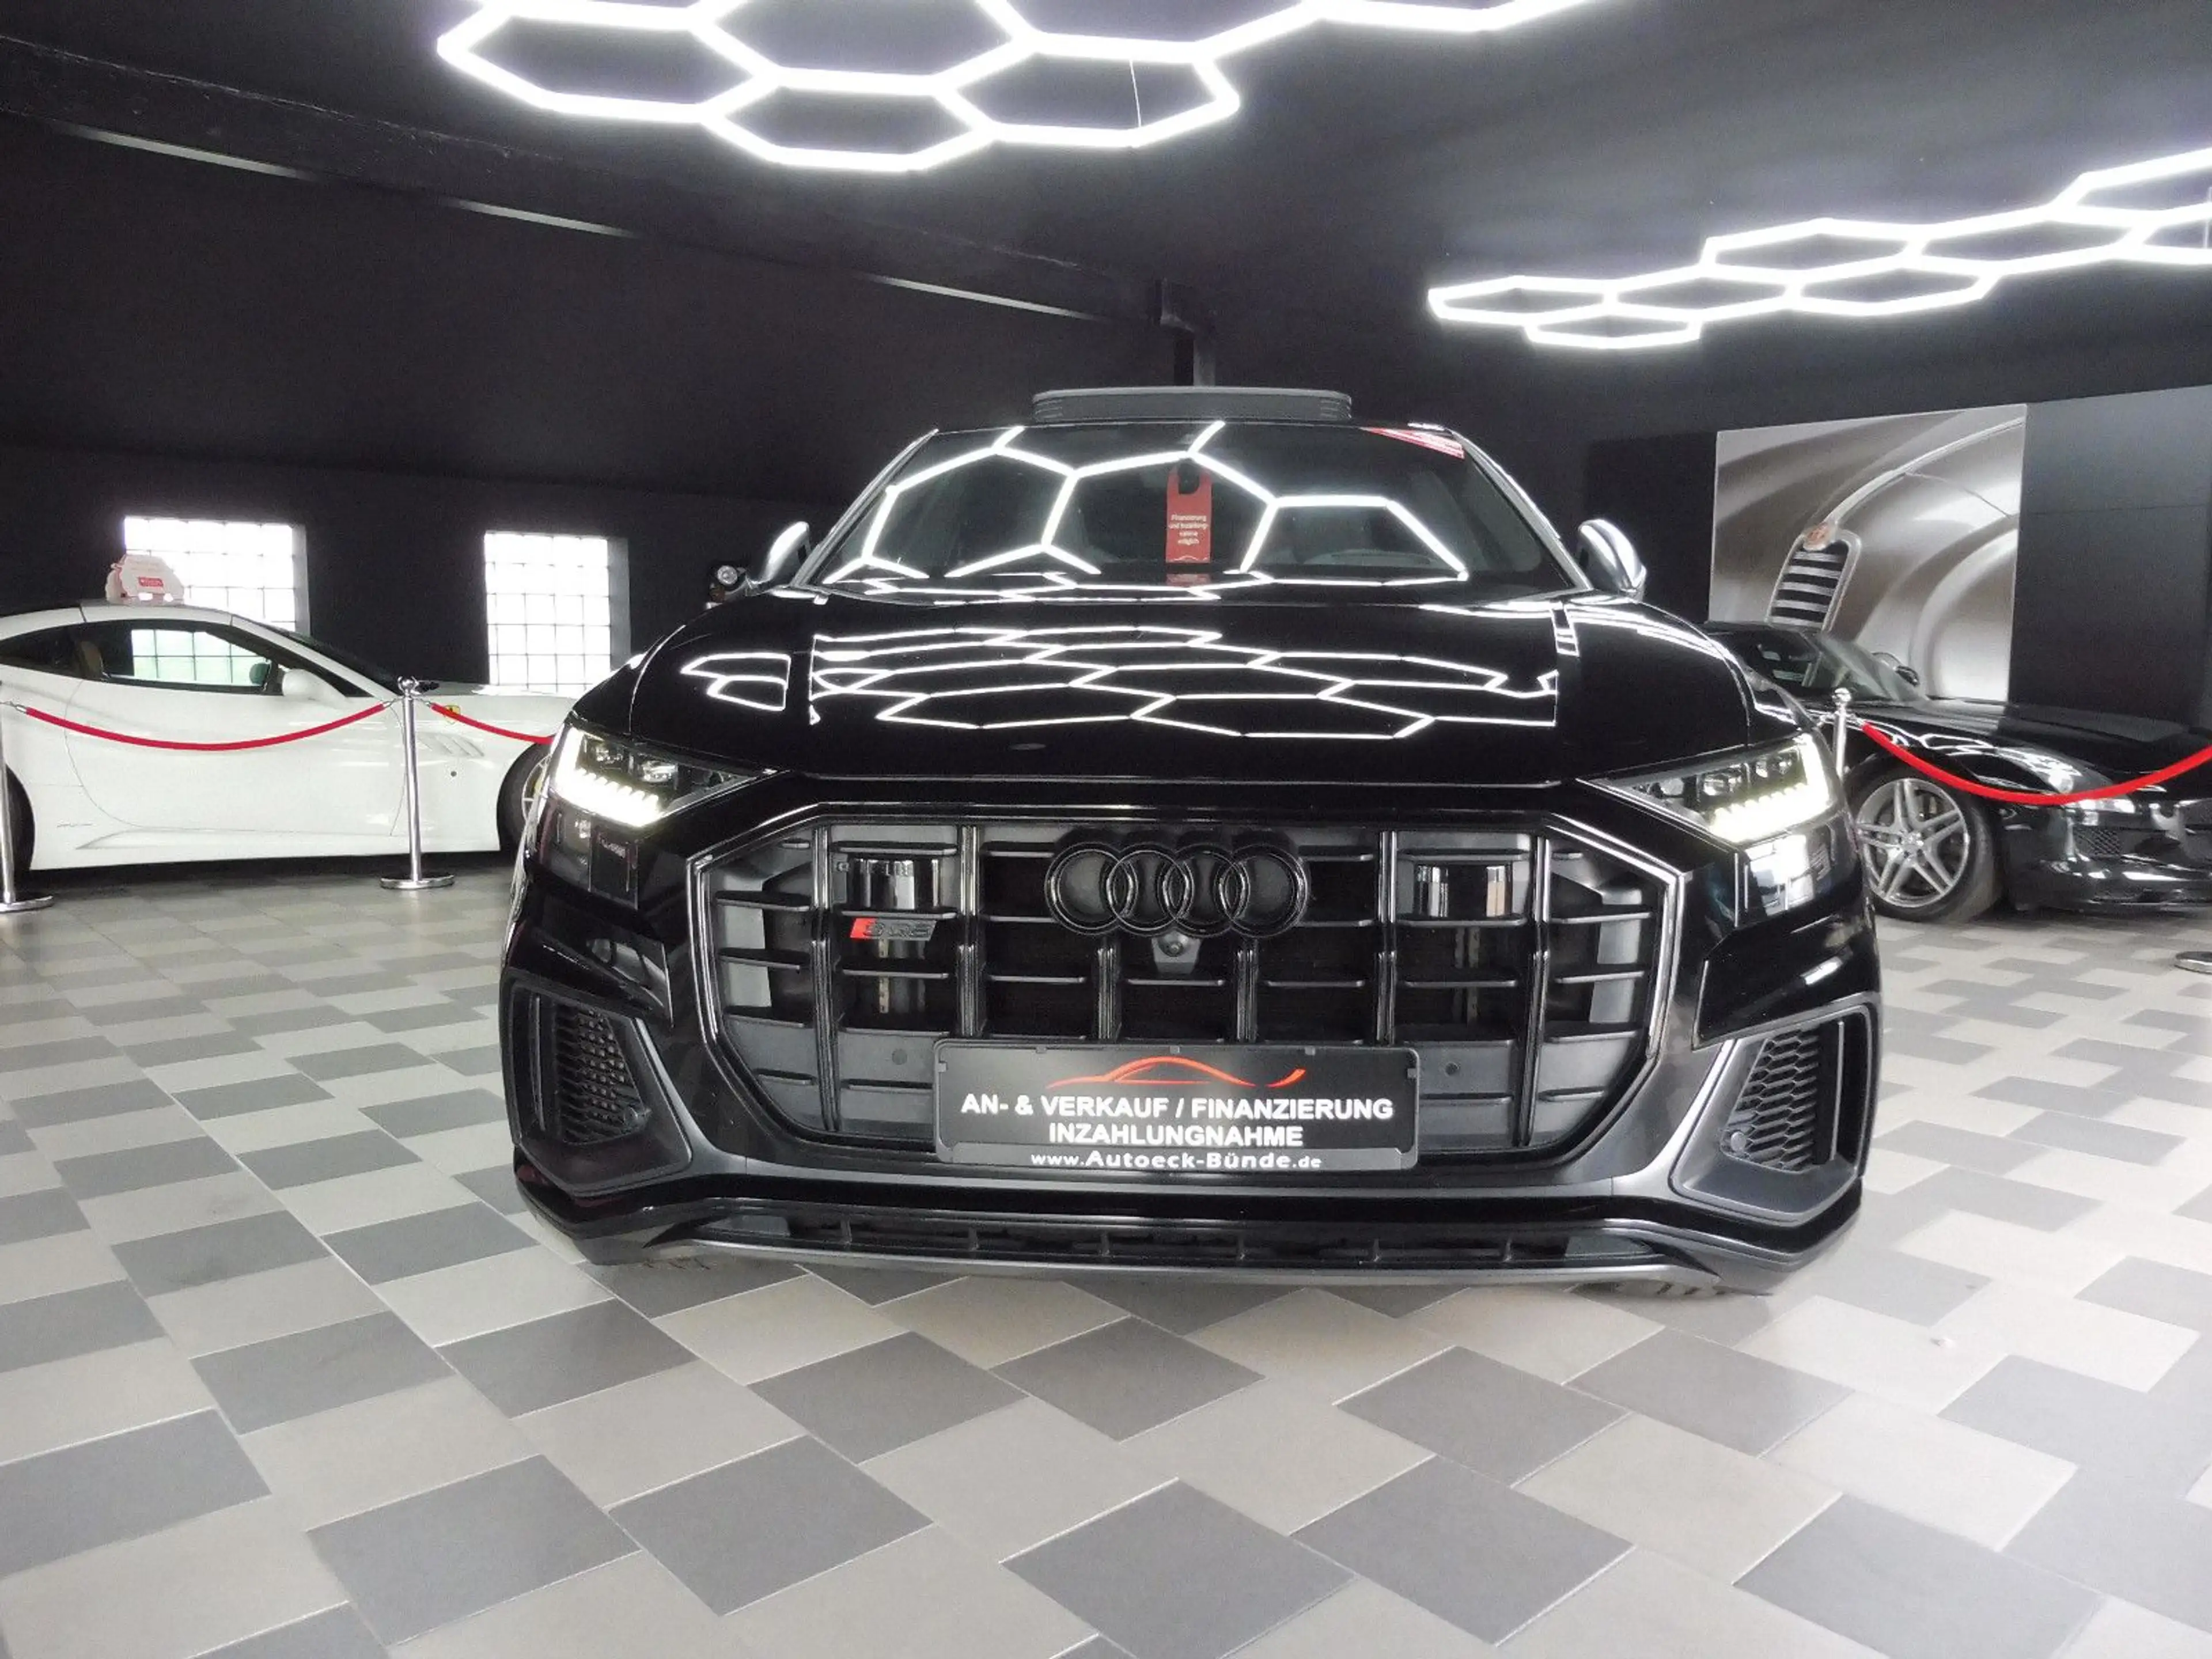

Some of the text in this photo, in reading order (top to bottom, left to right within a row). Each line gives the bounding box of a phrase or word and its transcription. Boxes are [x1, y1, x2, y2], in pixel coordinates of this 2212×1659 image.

[961, 1093, 1393, 1120] AN- & VERKAUF / FINANZIERUNG
[1049, 1121, 1304, 1147] INZAHLUNGNAHME
[1031, 1150, 1323, 1170] www.Autoeck-Bünde.de
